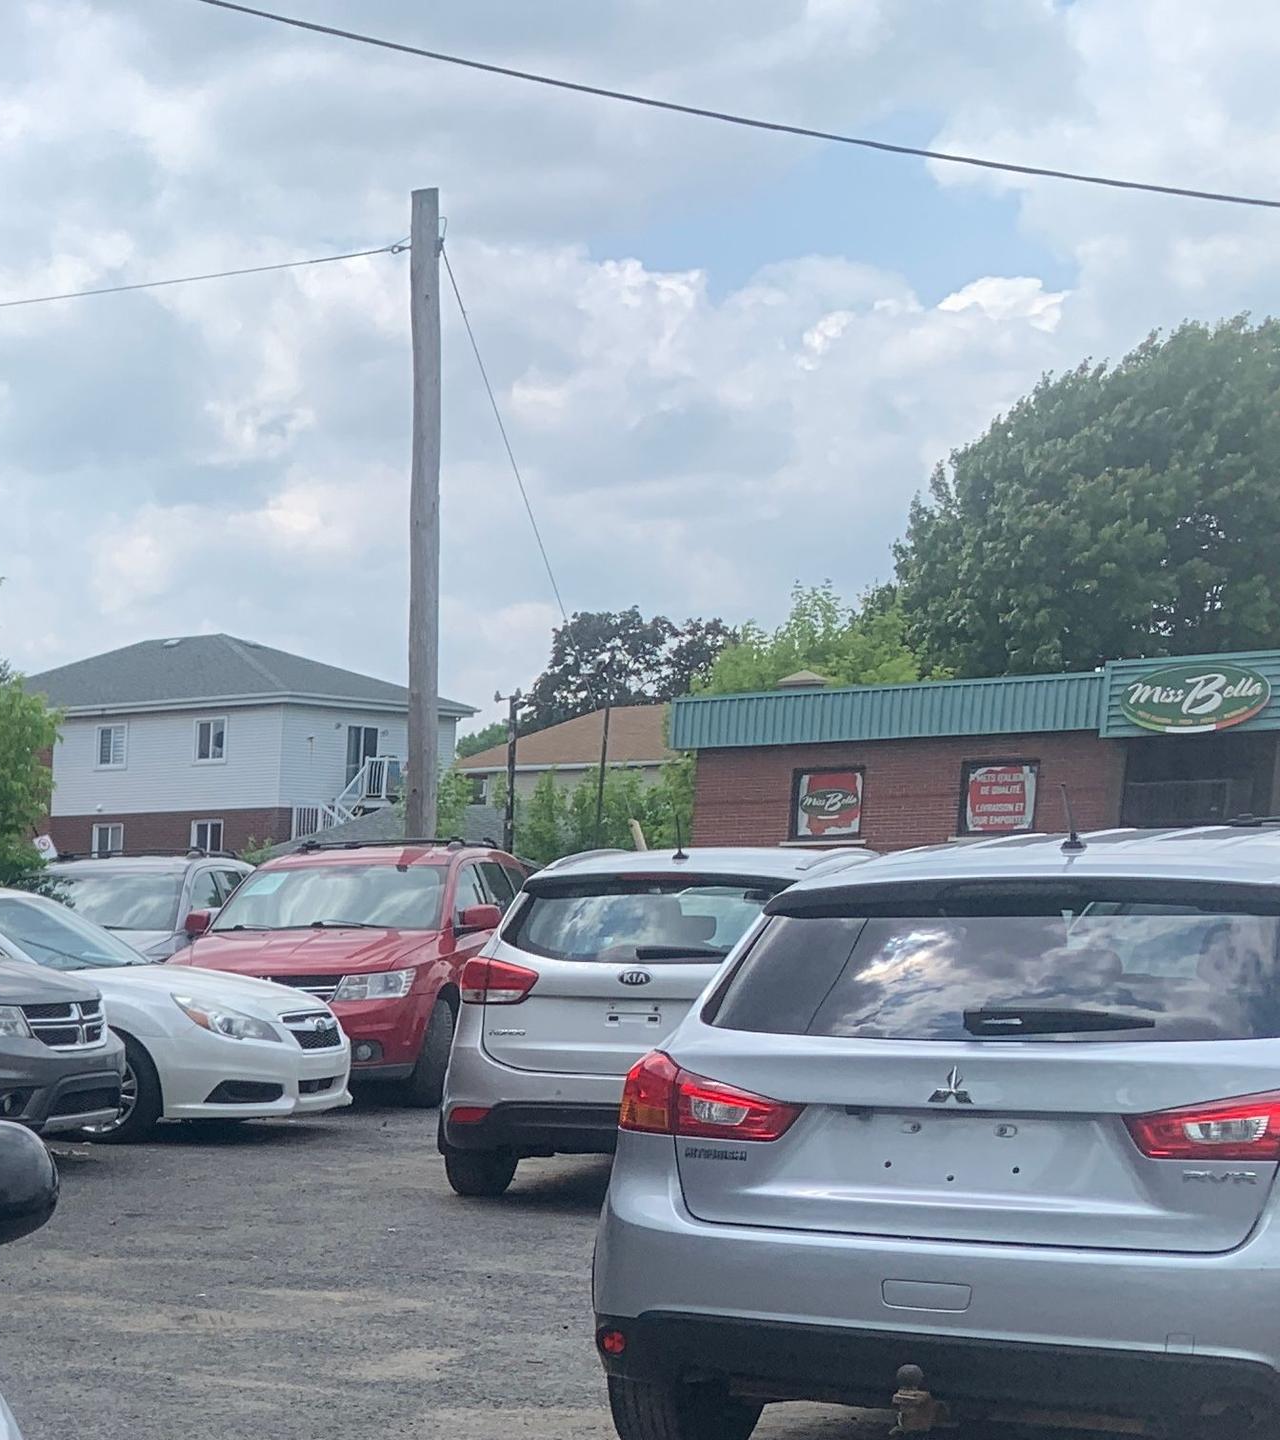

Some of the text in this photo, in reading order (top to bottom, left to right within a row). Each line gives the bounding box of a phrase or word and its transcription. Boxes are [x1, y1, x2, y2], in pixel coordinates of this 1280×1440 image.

[1127, 673, 1263, 714] Miss Bella
[623, 972, 646, 983] KIA
